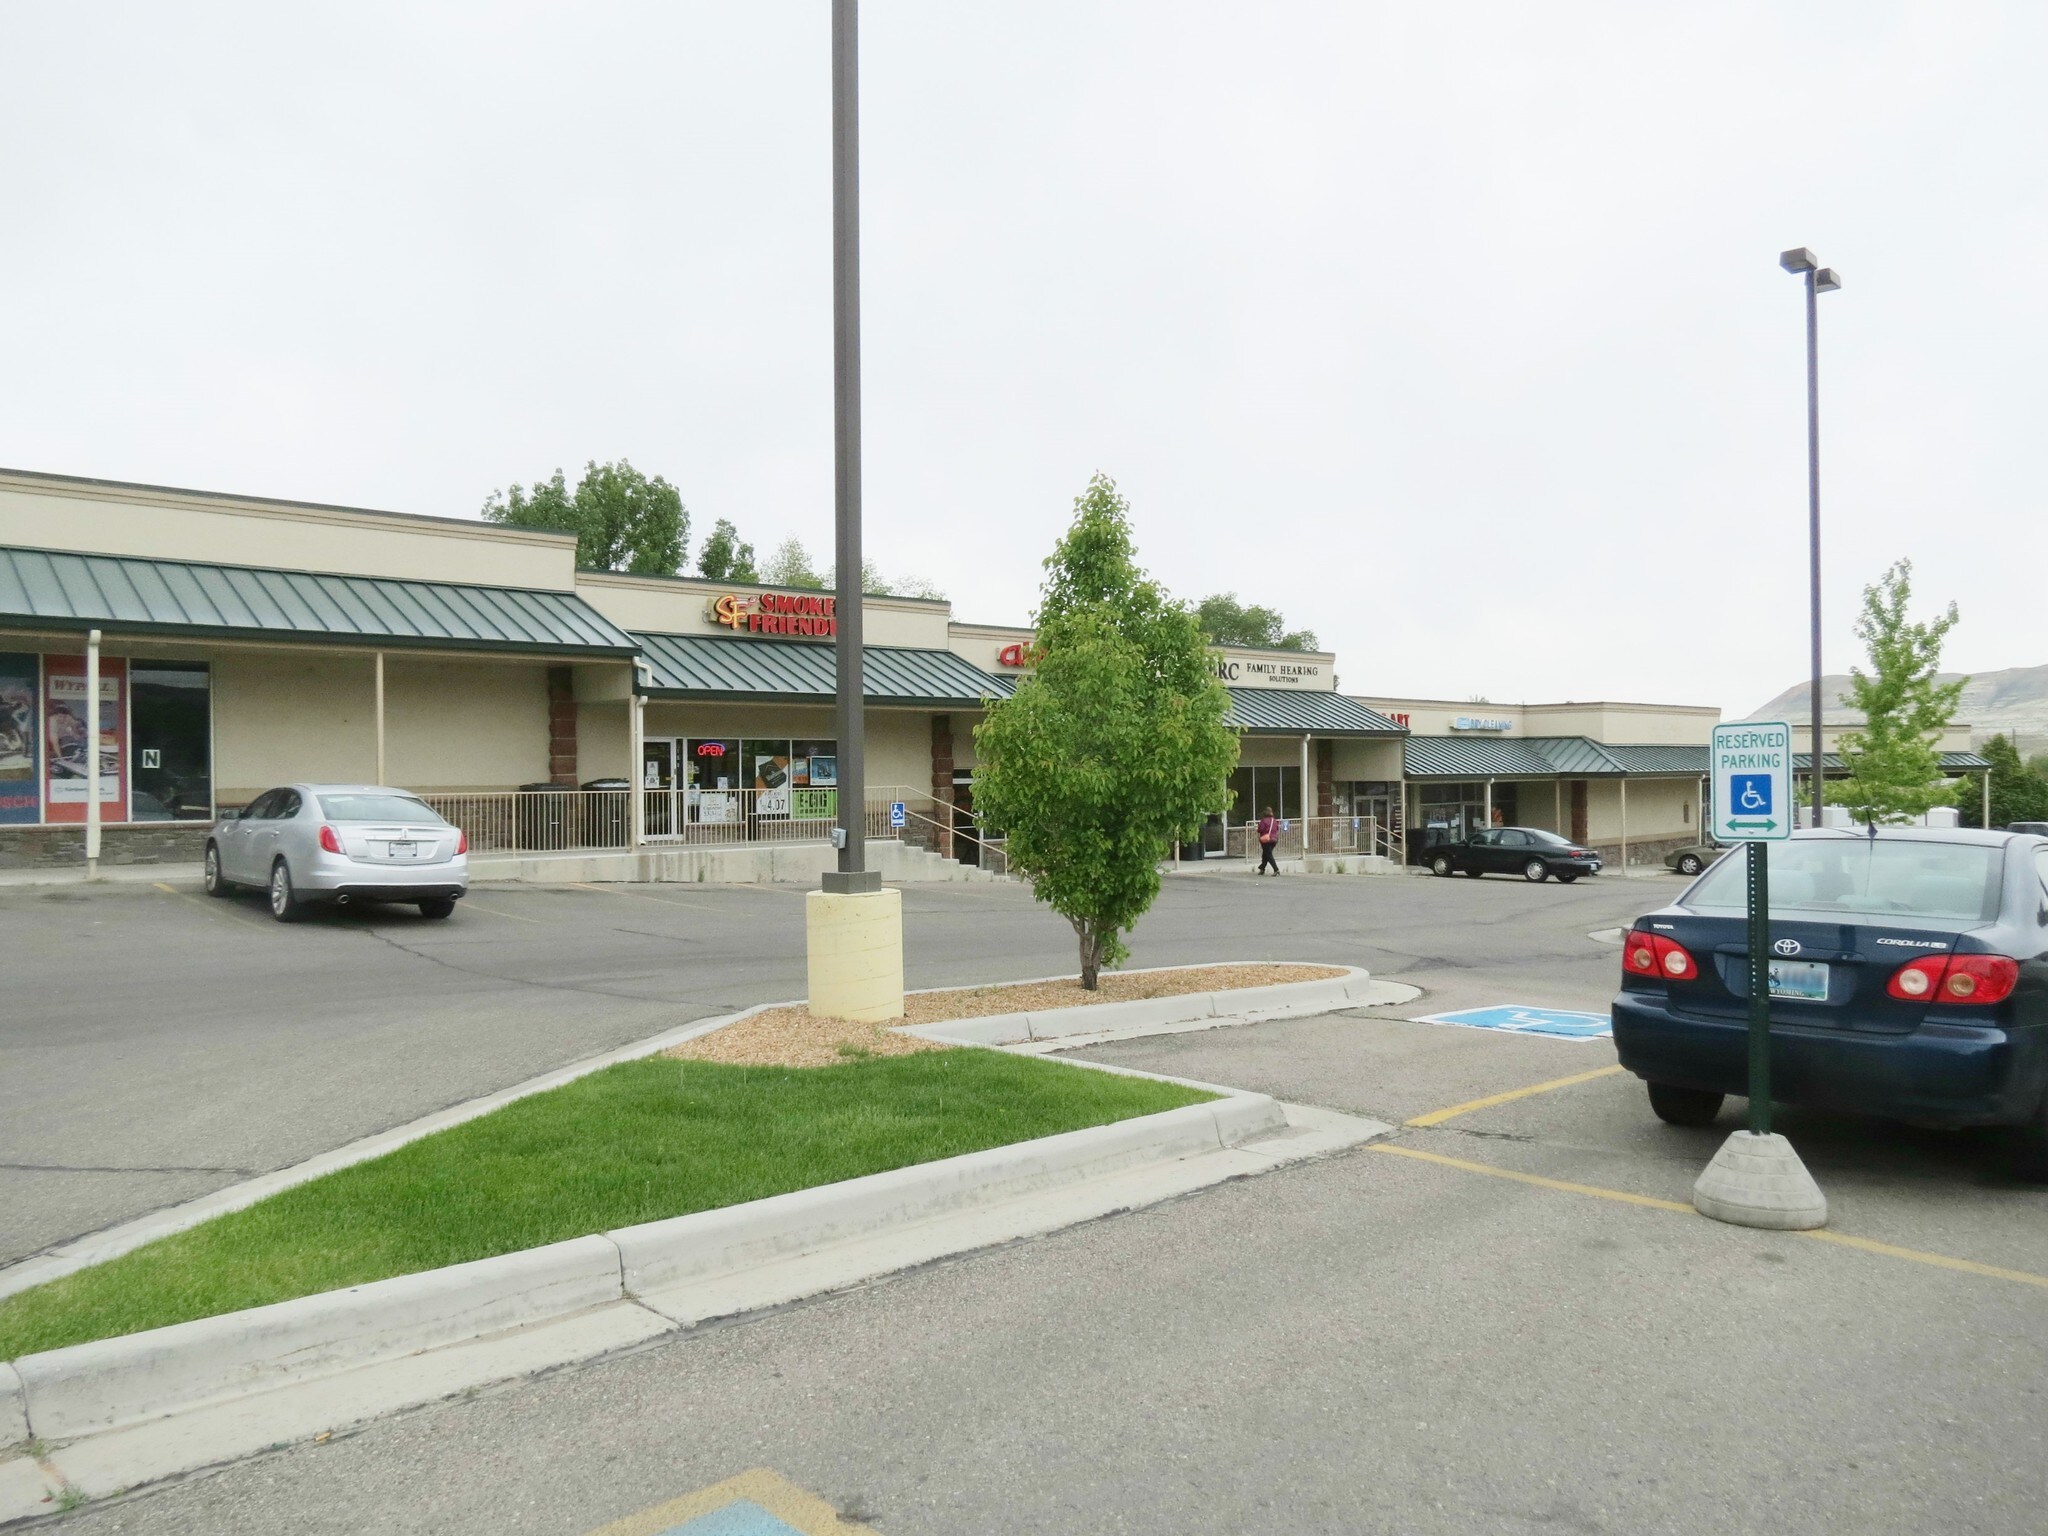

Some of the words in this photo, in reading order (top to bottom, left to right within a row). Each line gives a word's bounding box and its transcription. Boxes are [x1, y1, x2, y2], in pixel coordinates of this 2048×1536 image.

[1247, 663, 1276, 674] FAMILY
[1281, 665, 1318, 676] HEARING
[1269, 675, 1298, 683] SOLUTIONS
[1717, 732, 1785, 749] RESERVED
[697, 744, 723, 756] OPEN
[1721, 753, 1781, 769] PARKING
[1876, 938, 1930, 948] COROLLA
[1770, 987, 1806, 997] WYOMING
